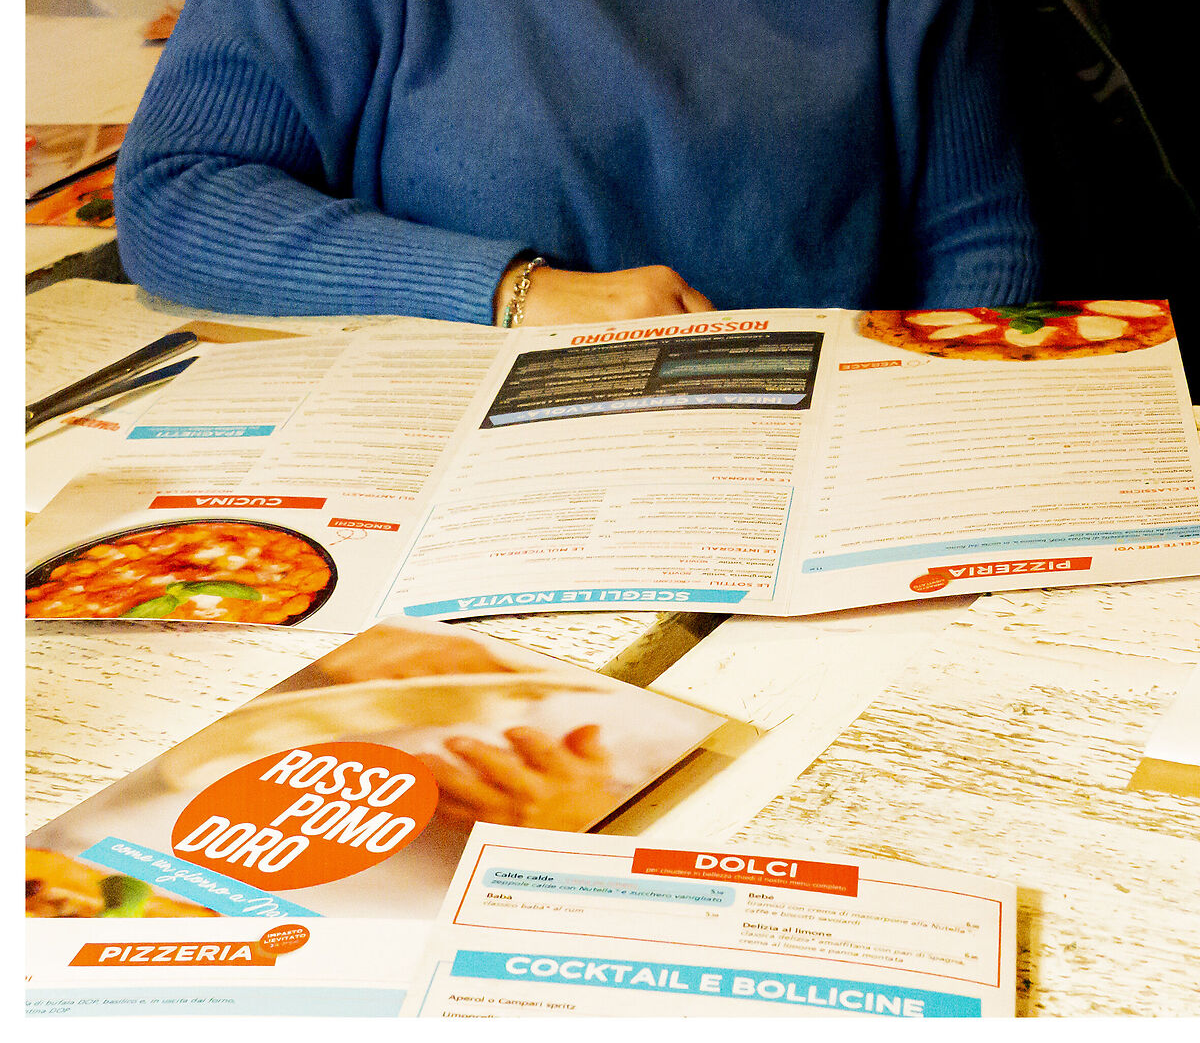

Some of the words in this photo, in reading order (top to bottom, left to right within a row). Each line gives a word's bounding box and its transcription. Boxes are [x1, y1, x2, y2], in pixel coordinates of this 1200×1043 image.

[570, 320, 769, 346] ROSSOPOMODORO
[155, 429, 245, 438] SPAGHETTI
[195, 497, 282, 506] CUCINA
[335, 520, 392, 530] GNOCCHI
[701, 546, 760, 554] INTEGRALI
[948, 561, 1071, 578] PIZZERIA
[457, 592, 555, 611] NOVITÀ
[561, 591, 593, 602] LE
[600, 590, 691, 602] SCEGLI
[259, 748, 417, 809] ROSSO
[271, 792, 417, 854] POMO
[173, 814, 310, 874] DORO
[110, 842, 152, 867] come
[160, 867, 231, 898] giorno
[694, 854, 798, 878] DOLCI
[494, 871, 525, 881] Calde
[526, 874, 554, 882] calde
[491, 879, 531, 889] zeppole
[532, 882, 557, 890] calde
[630, 889, 672, 899] zucchero
[673, 893, 723, 903] vanigliato
[812, 882, 847, 892] completo
[789, 904, 806, 912] con
[807, 906, 837, 916] crema
[817, 915, 861, 926] savoiardi
[267, 928, 304, 939] IMPASTO
[742, 921, 779, 932] Delizia
[782, 925, 793, 933] al
[794, 927, 833, 938] limone
[263, 933, 307, 944] LIEVITATO
[818, 937, 871, 951] amalfitana
[874, 944, 892, 952] con
[98, 945, 253, 963] PIZZERIA
[739, 939, 770, 948] crema
[861, 951, 904, 964] montata
[505, 956, 689, 990] COCKTAIL
[699, 972, 723, 994] E
[731, 976, 925, 1018] BOLLICINE
[45, 999, 75, 1007] bufala
[448, 993, 485, 1004] Aperol
[498, 997, 543, 1009] Campari
[546, 1000, 577, 1011] spritz
